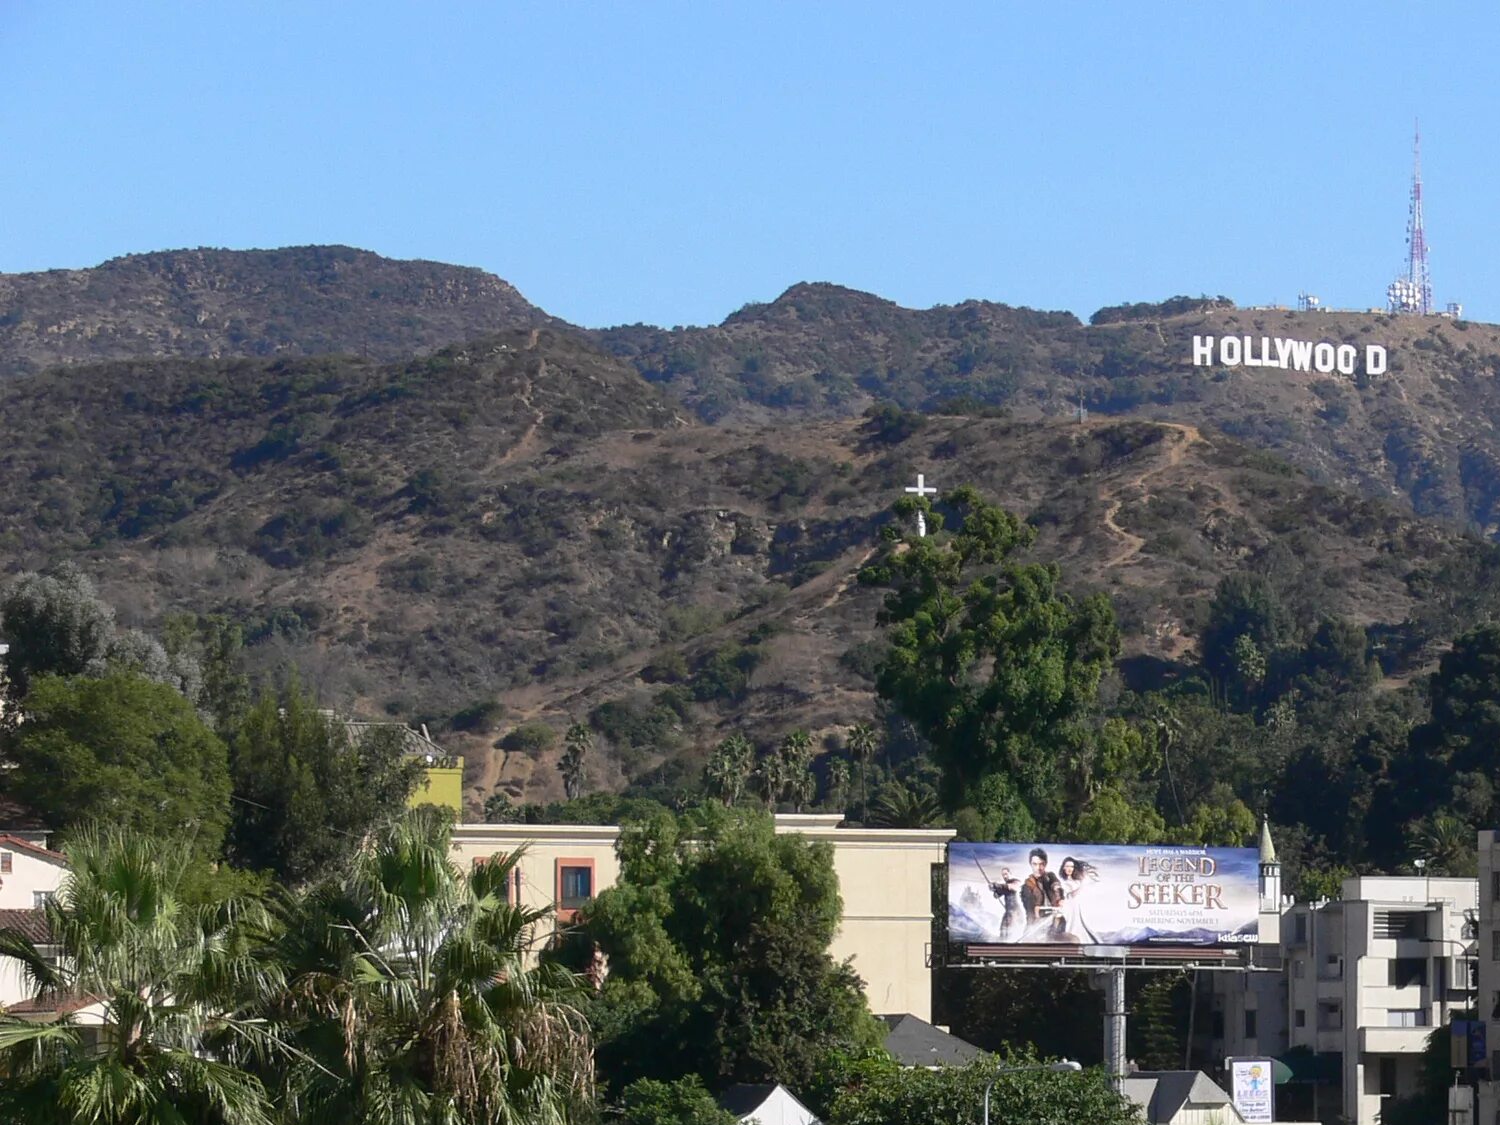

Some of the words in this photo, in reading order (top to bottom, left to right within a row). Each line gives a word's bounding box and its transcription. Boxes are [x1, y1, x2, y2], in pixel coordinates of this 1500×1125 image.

[1193, 336, 1387, 375] HOLLYWOOD
[1137, 856, 1217, 878] LEGEND
[1157, 874, 1169, 883] OF
[1173, 874, 1195, 883] THE
[1128, 883, 1228, 910] SEEKER
